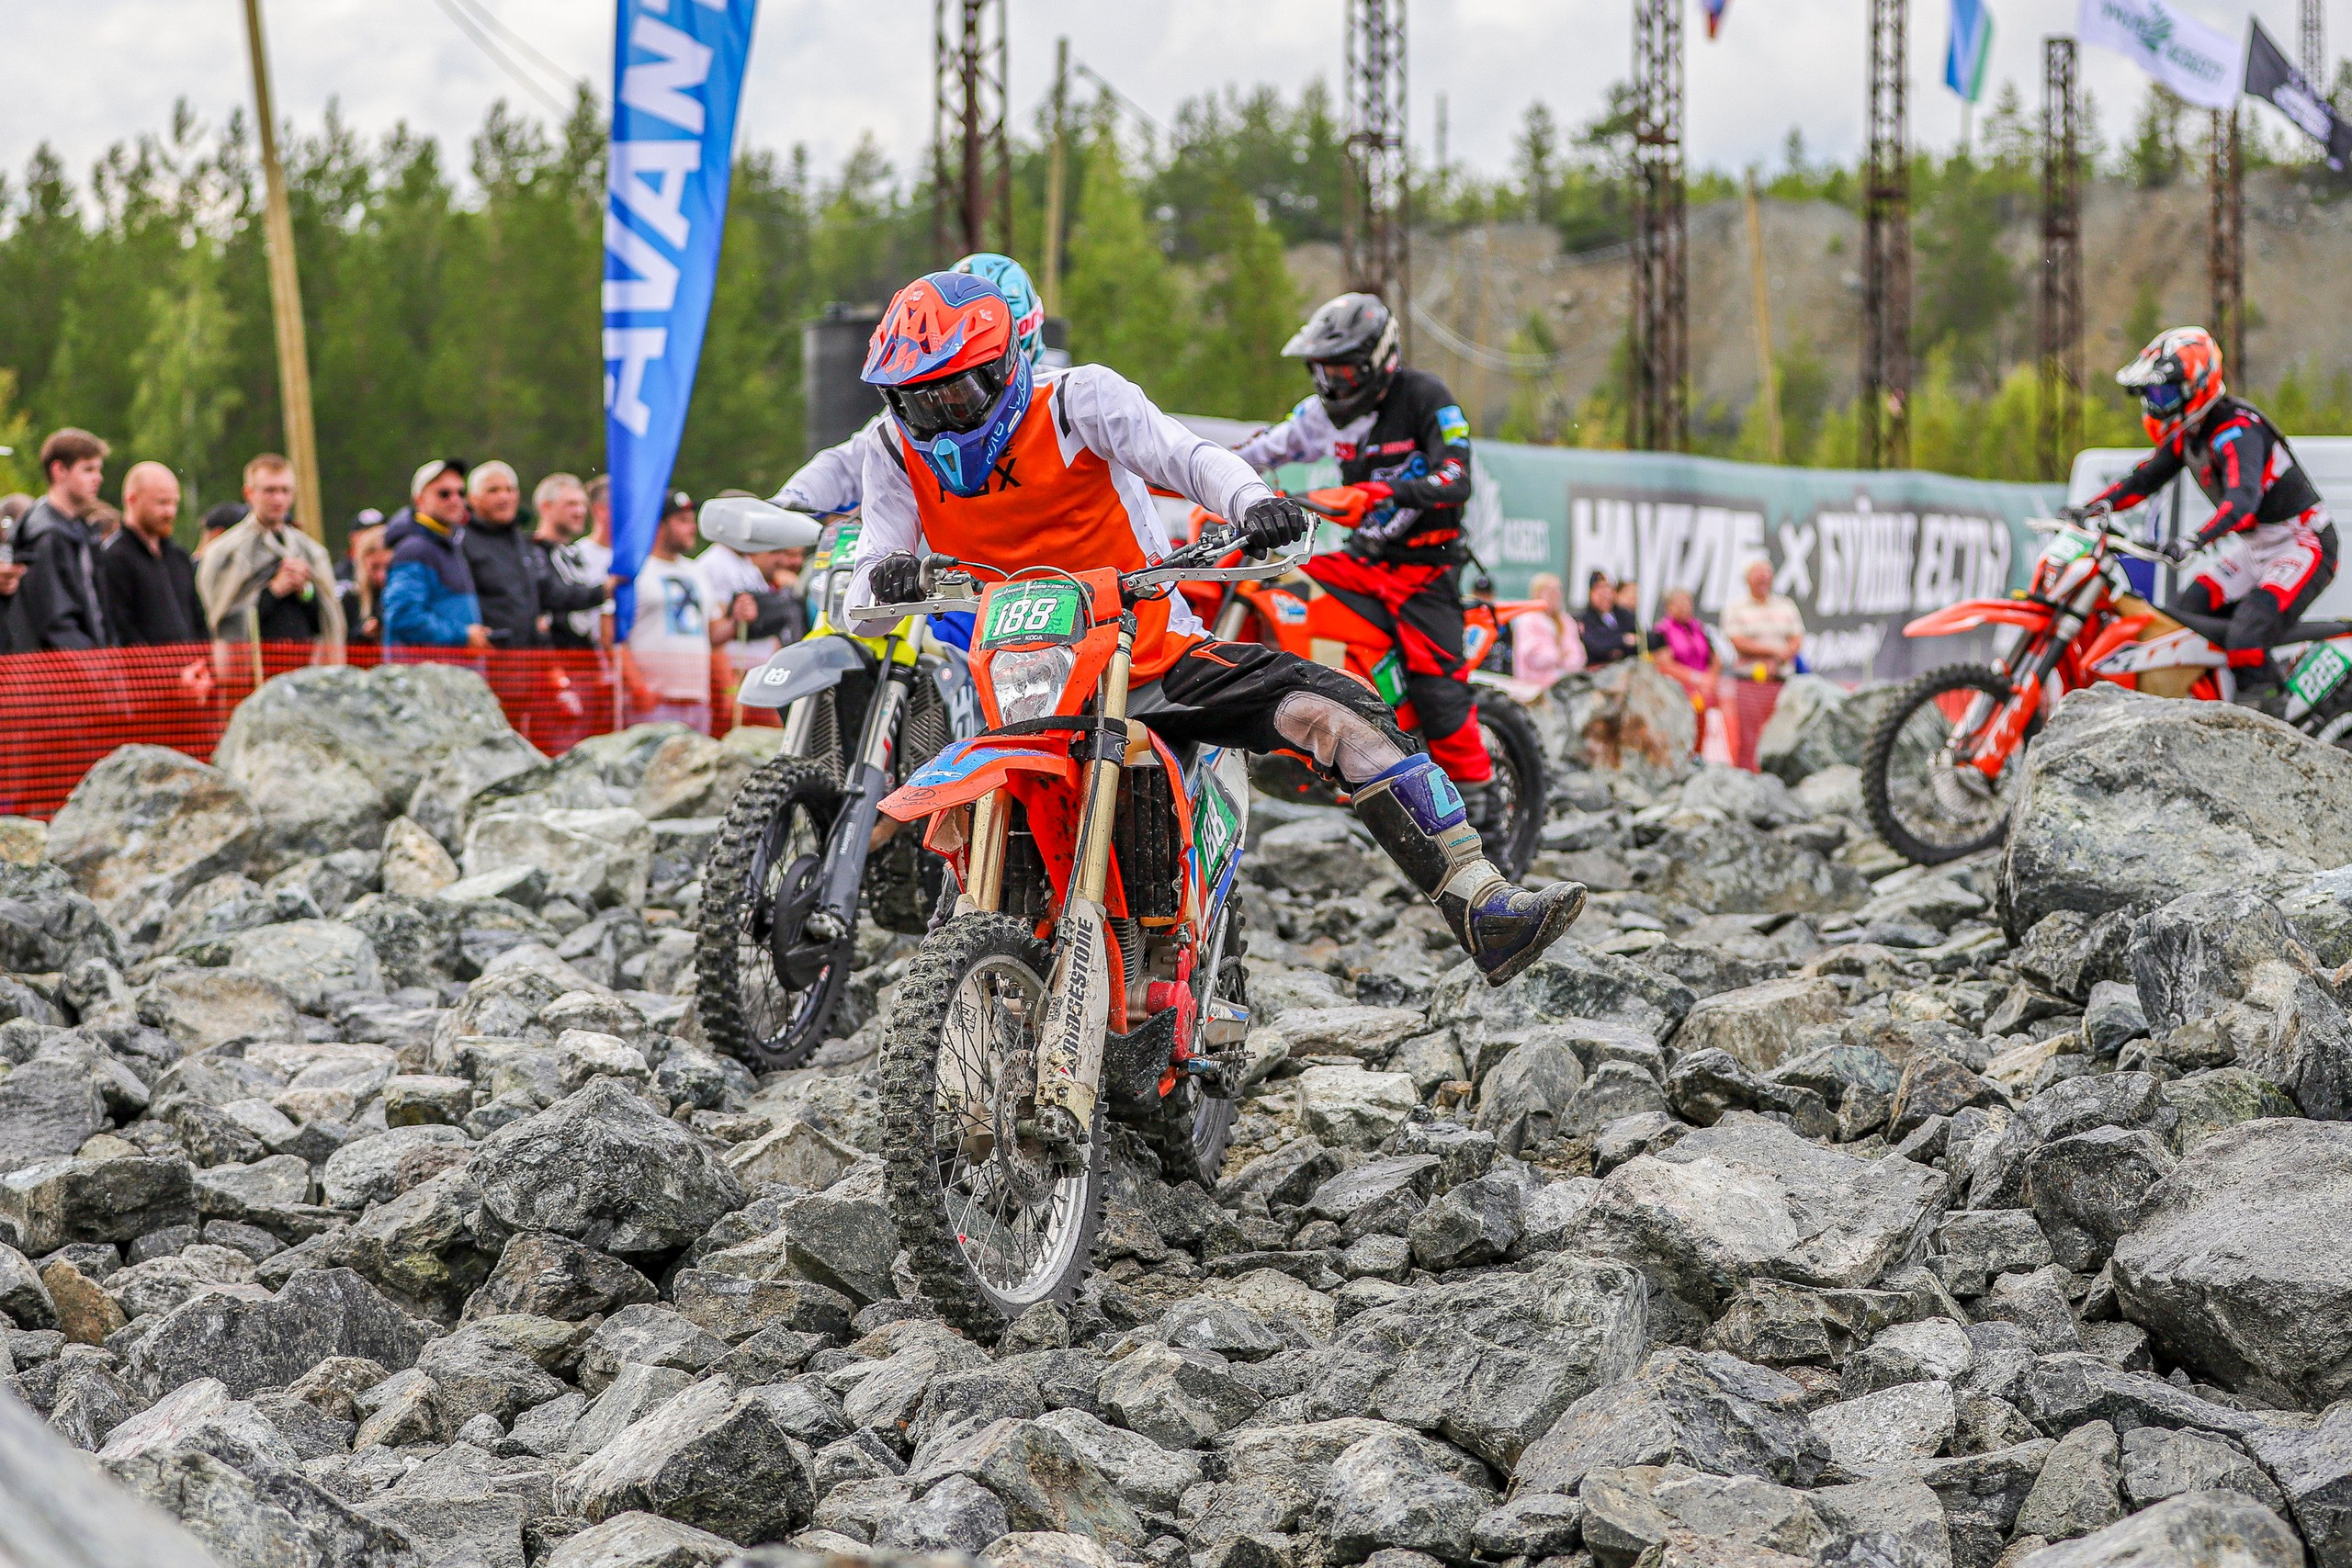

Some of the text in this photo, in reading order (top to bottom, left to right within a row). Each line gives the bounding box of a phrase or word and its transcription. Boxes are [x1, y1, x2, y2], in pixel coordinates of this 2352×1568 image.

[602, 0, 728, 436] AVAN
[991, 597, 1058, 637] 188
[2297, 648, 2346, 704] 225
[1201, 794, 1227, 876] 188
